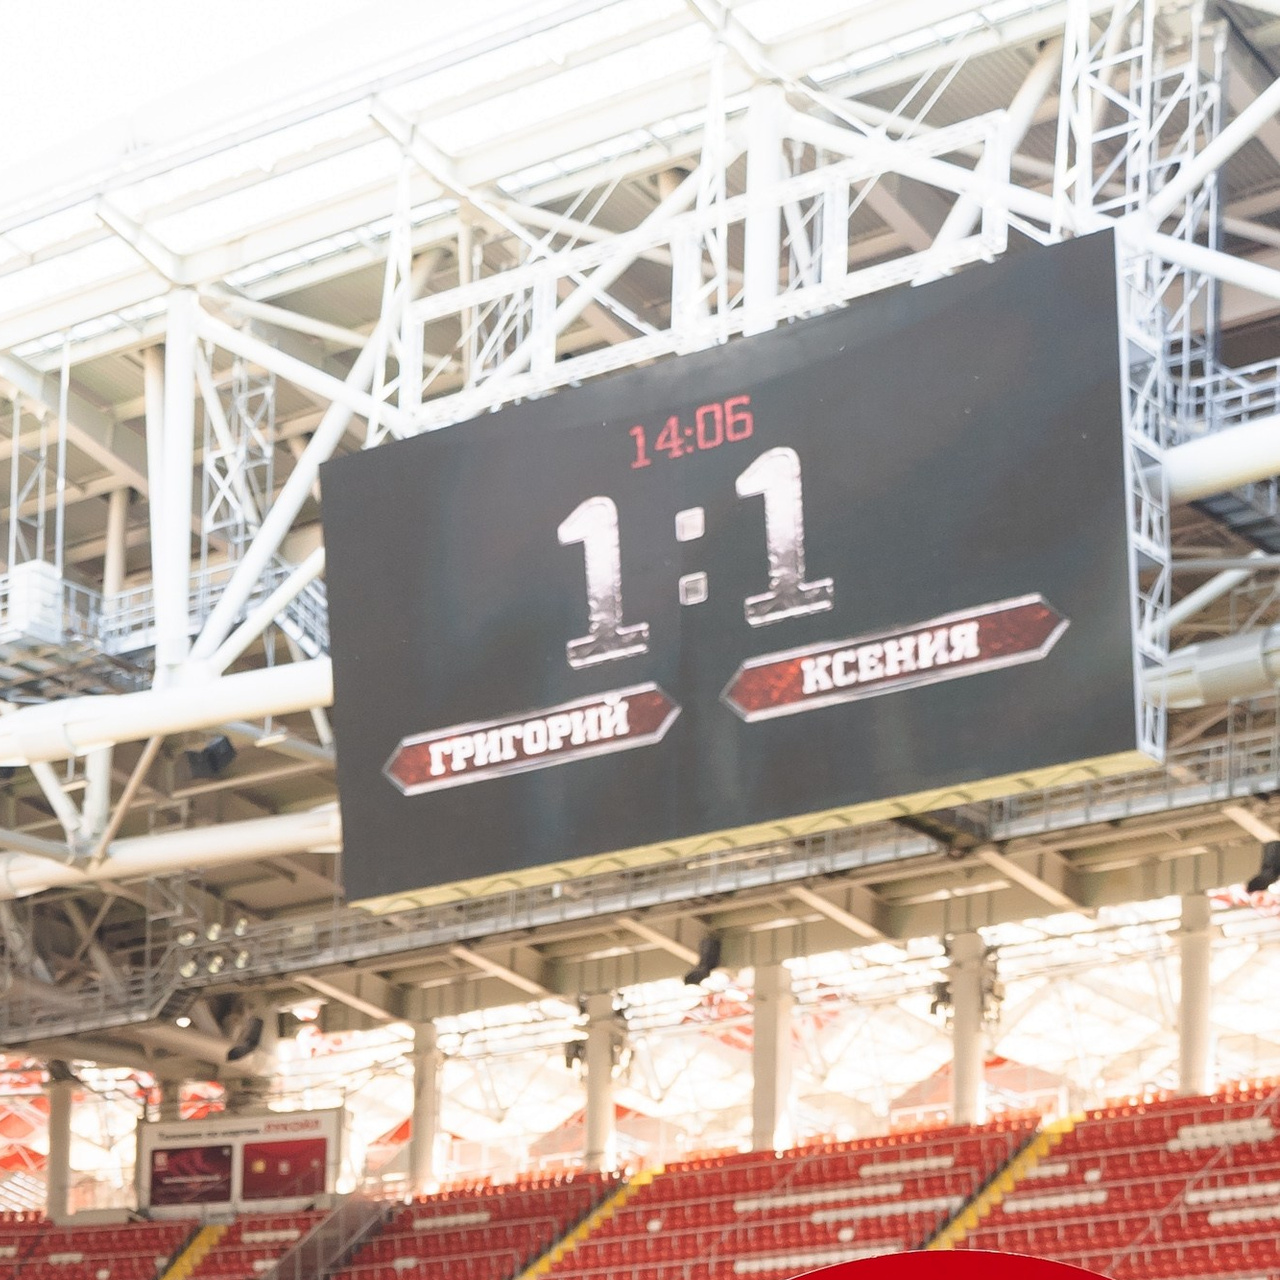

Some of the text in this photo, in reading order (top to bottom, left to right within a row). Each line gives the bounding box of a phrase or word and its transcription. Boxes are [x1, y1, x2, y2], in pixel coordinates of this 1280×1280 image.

[628, 394, 754, 470] 14:06
[800, 621, 981, 695] КСЕНИЯ
[428, 693, 631, 776] ГРИГОРИЙ
